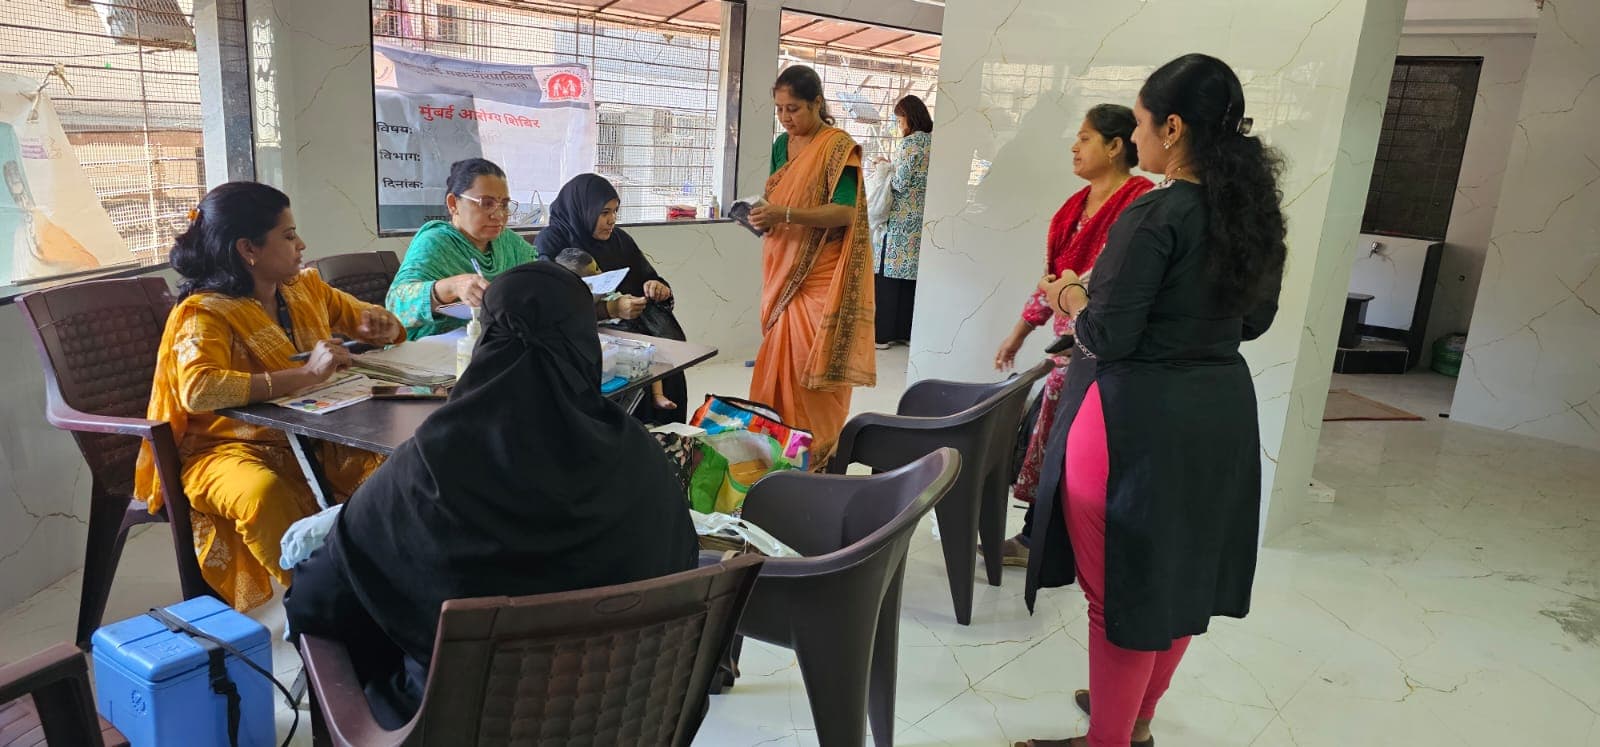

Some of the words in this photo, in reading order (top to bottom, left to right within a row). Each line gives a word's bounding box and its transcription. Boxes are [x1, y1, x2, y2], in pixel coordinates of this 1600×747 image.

[418, 104, 455, 122] मुंबई
[458, 108, 502, 123] आरोग्य
[503, 113, 541, 129] शिबिर
[376, 121, 413, 135] विषय:
[379, 149, 421, 162] विभाग:
[382, 177, 424, 189] दिनांक:
